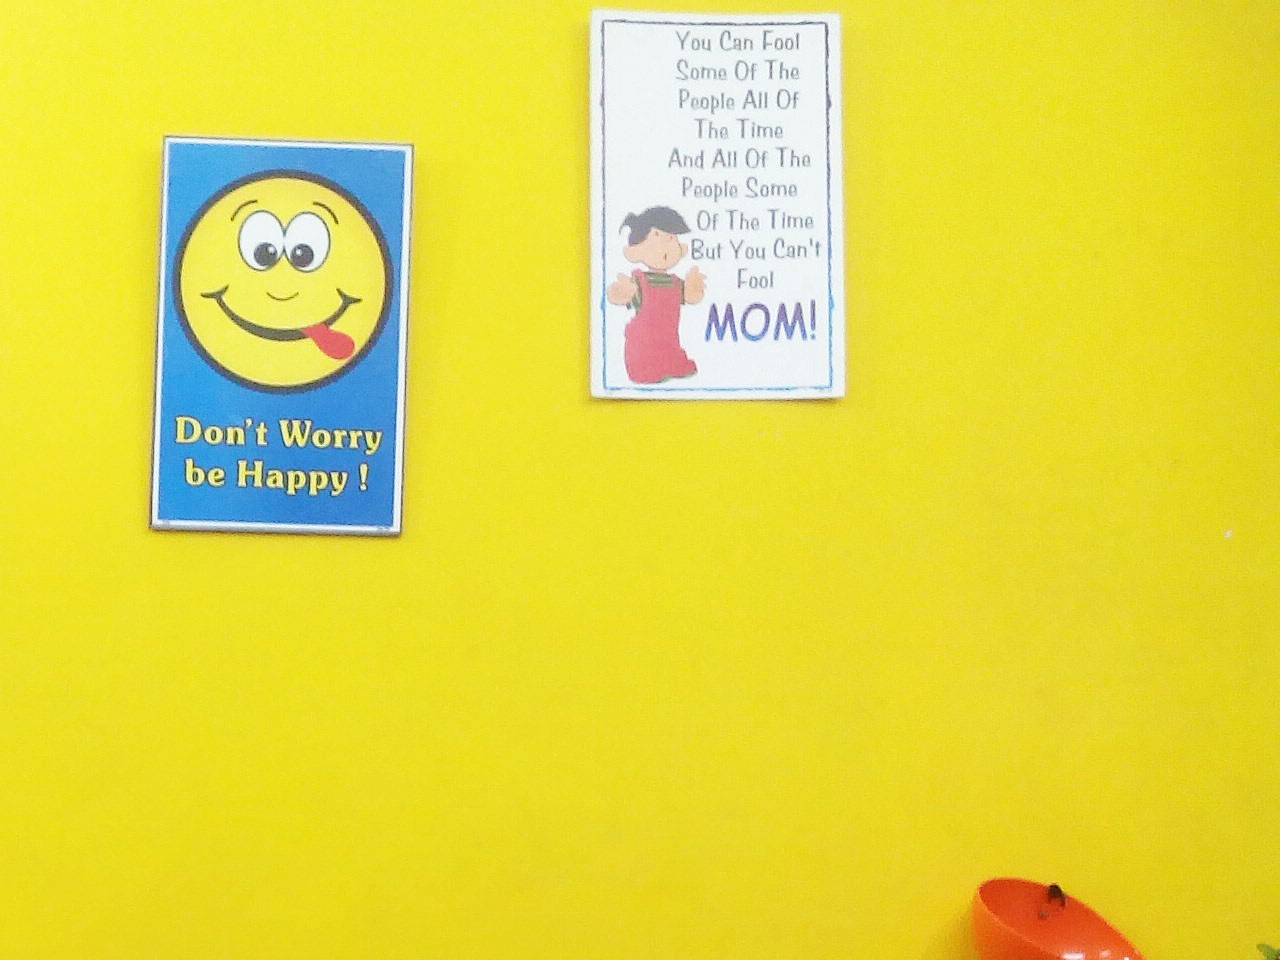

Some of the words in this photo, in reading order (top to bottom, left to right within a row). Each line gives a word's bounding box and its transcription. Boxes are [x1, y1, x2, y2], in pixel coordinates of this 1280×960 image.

[675, 31, 711, 51] You
[719, 30, 754, 51] Can
[762, 31, 800, 51] Fool
[676, 59, 726, 81] Some
[734, 60, 757, 81] Of
[765, 59, 800, 80] The
[679, 88, 735, 114] People
[742, 89, 768, 110] All
[776, 89, 799, 110] Of
[694, 118, 729, 139] The
[736, 118, 784, 139] Time
[668, 148, 704, 169] And
[711, 149, 737, 168] All
[745, 148, 769, 168] Of
[776, 147, 811, 168] The
[682, 177, 738, 203] People
[745, 177, 797, 198] Some
[696, 210, 720, 231] Of
[726, 209, 760, 231] The
[768, 208, 814, 230] Time
[690, 239, 721, 261] But
[730, 240, 765, 260] You
[773, 238, 822, 258] Can't
[737, 268, 774, 289] Fool
[704, 299, 816, 343] MOM!
[175, 415, 268, 446] Don't
[278, 419, 383, 456] Worry
[184, 457, 226, 487] be
[237, 459, 348, 497] Happy
